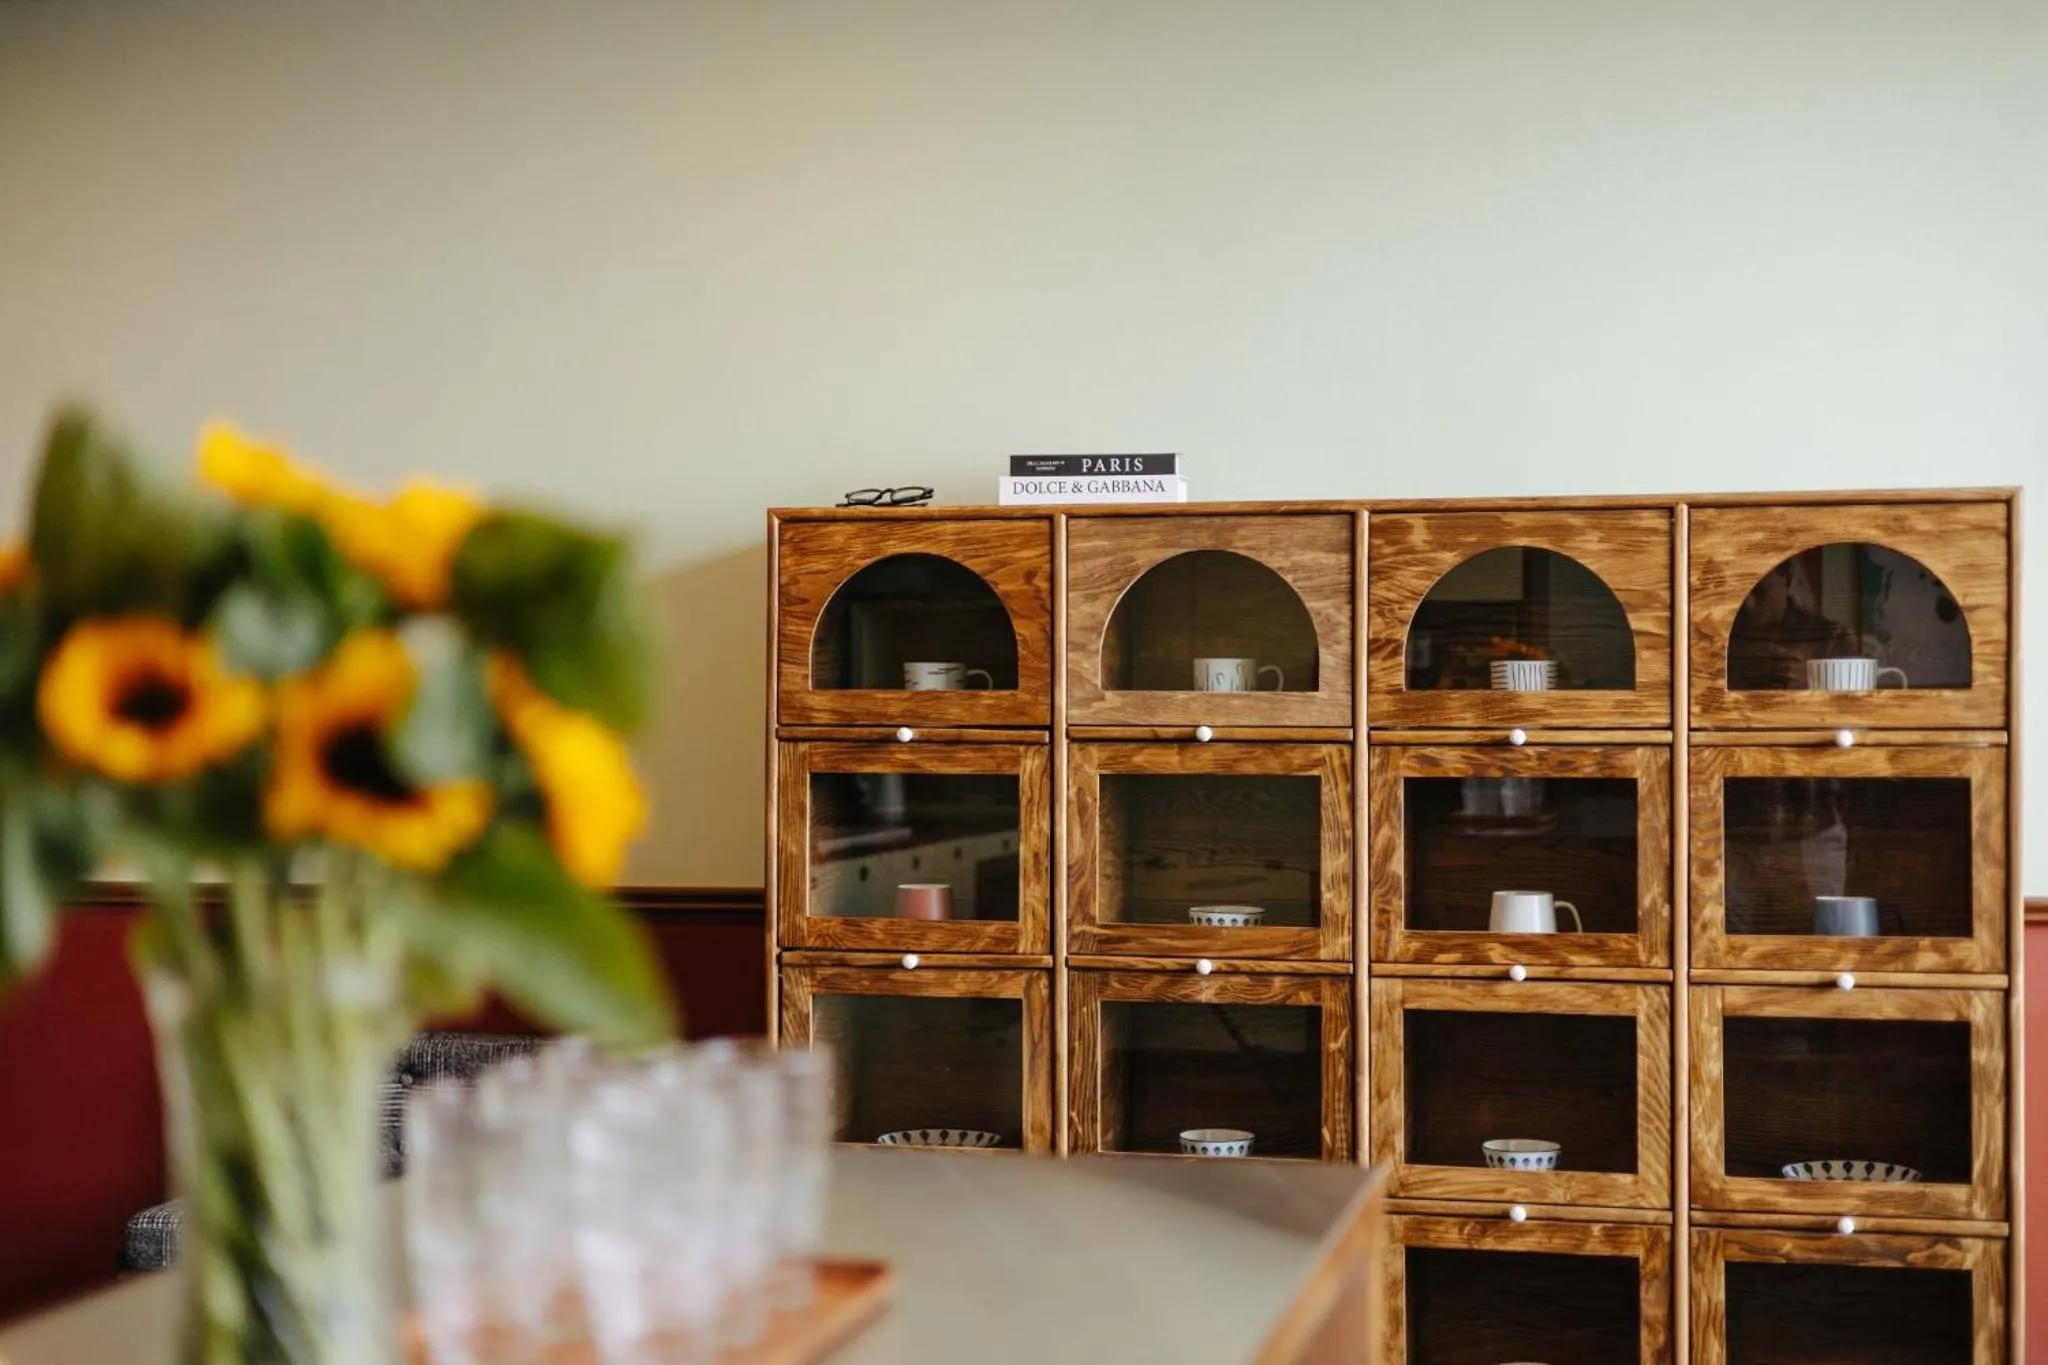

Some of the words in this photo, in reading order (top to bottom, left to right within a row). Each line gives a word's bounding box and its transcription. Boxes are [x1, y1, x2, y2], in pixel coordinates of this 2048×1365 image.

[1082, 458, 1144, 473] PARIS
[1013, 481, 1067, 495] DOLCE
[1071, 481, 1083, 494] &
[1087, 479, 1166, 494] GABBANA
